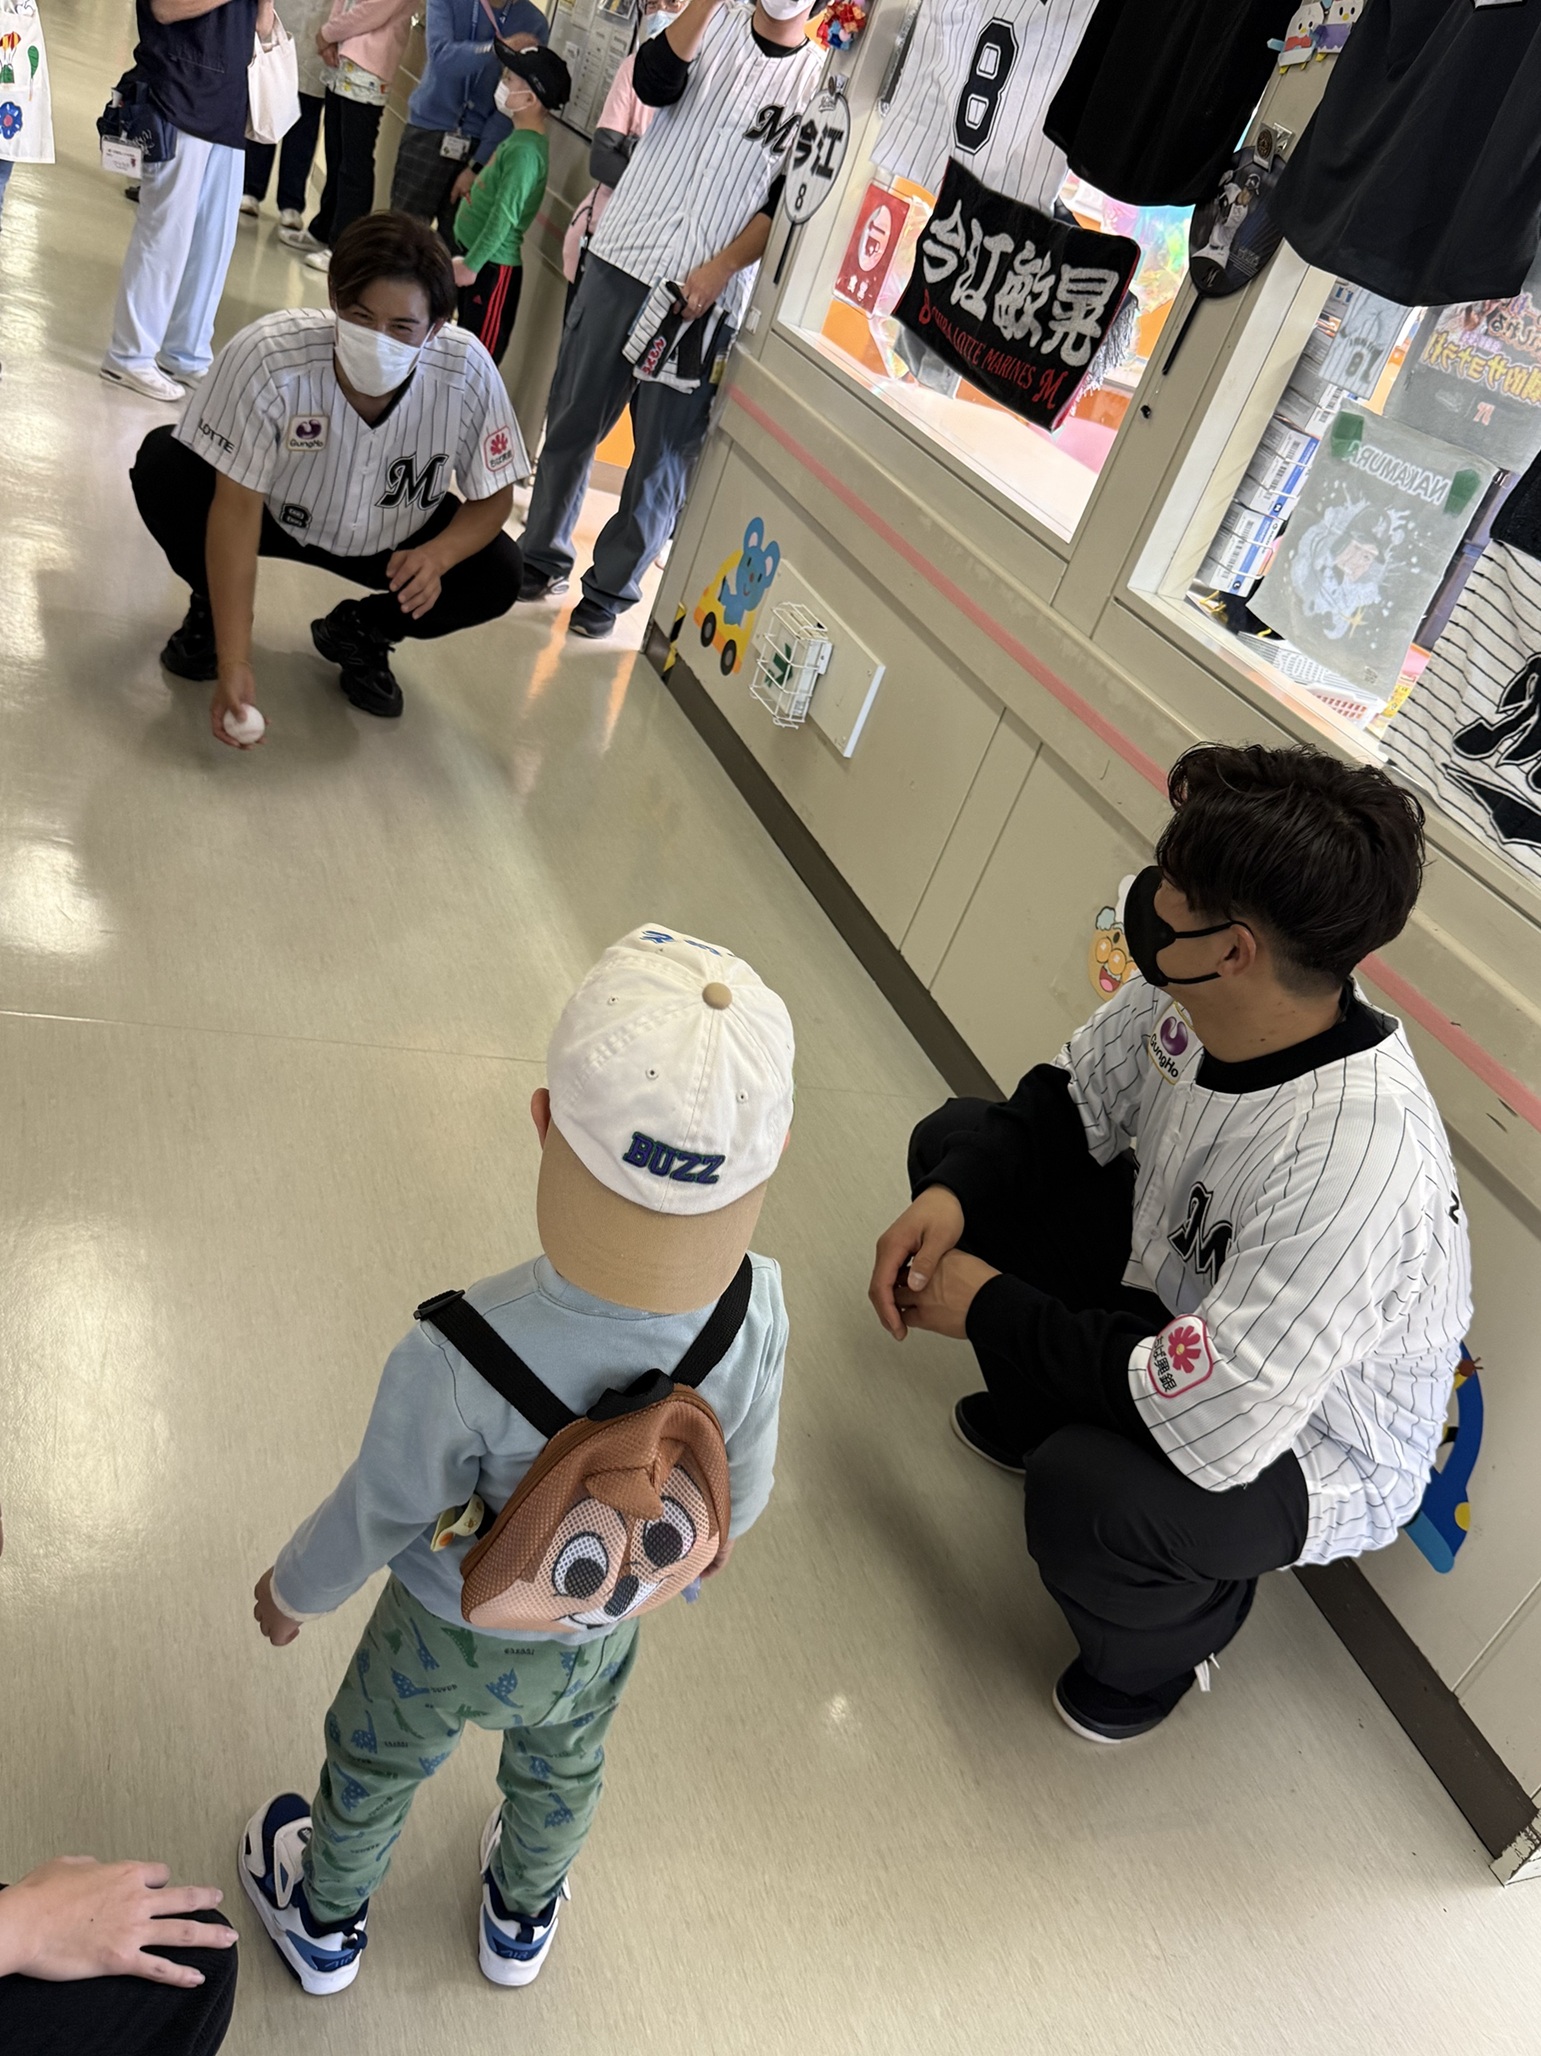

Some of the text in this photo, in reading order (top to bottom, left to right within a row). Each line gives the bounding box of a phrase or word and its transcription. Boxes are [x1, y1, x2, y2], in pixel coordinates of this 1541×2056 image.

[953, 17, 1019, 156] 8
[793, 119, 844, 180] 今江
[794, 184, 808, 210] 8
[922, 199, 1120, 367] 今江敏晃
[953, 328, 987, 366] LOTTE
[982, 347, 1037, 390] MARINES
[198, 418, 235, 454] LOTTE
[290, 438, 323, 449] GungHo
[375, 452, 449, 511] M
[1149, 1033, 1179, 1078] GungHo
[622, 1131, 726, 1184] BUZZ
[1153, 1336, 1178, 1392] ちば興銀
